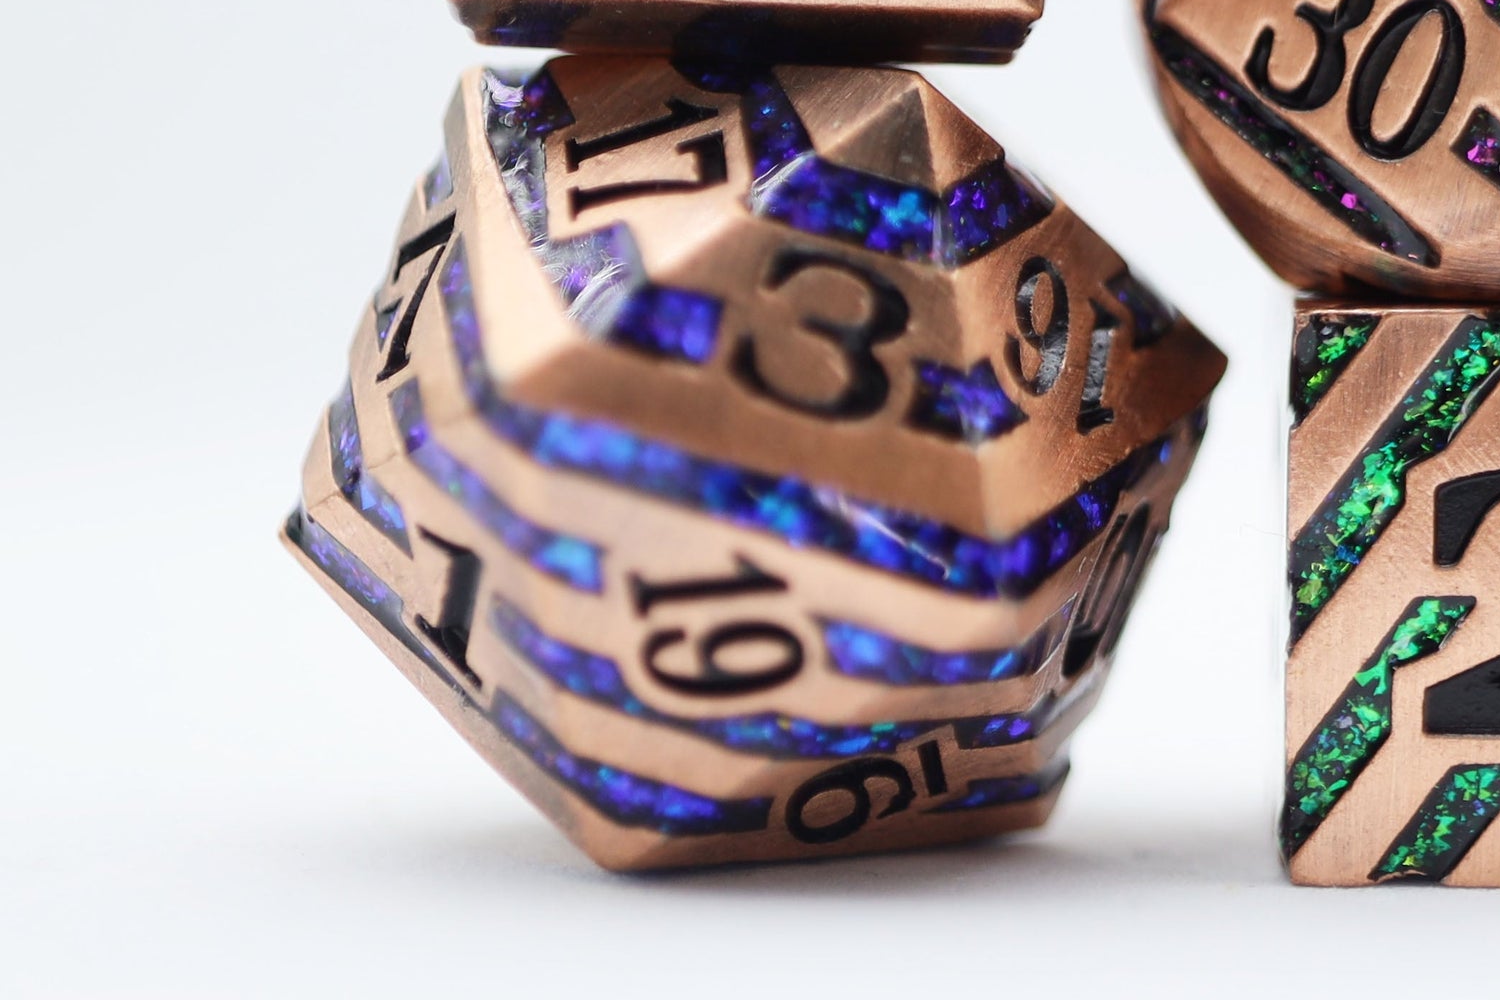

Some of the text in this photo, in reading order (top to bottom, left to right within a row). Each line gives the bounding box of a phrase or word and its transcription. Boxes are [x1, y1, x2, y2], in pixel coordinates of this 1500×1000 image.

[566, 98, 728, 221] 17
[375, 209, 457, 385] 7
[728, 242, 911, 423] 3
[414, 523, 484, 692] 1
[626, 551, 806, 699] 19
